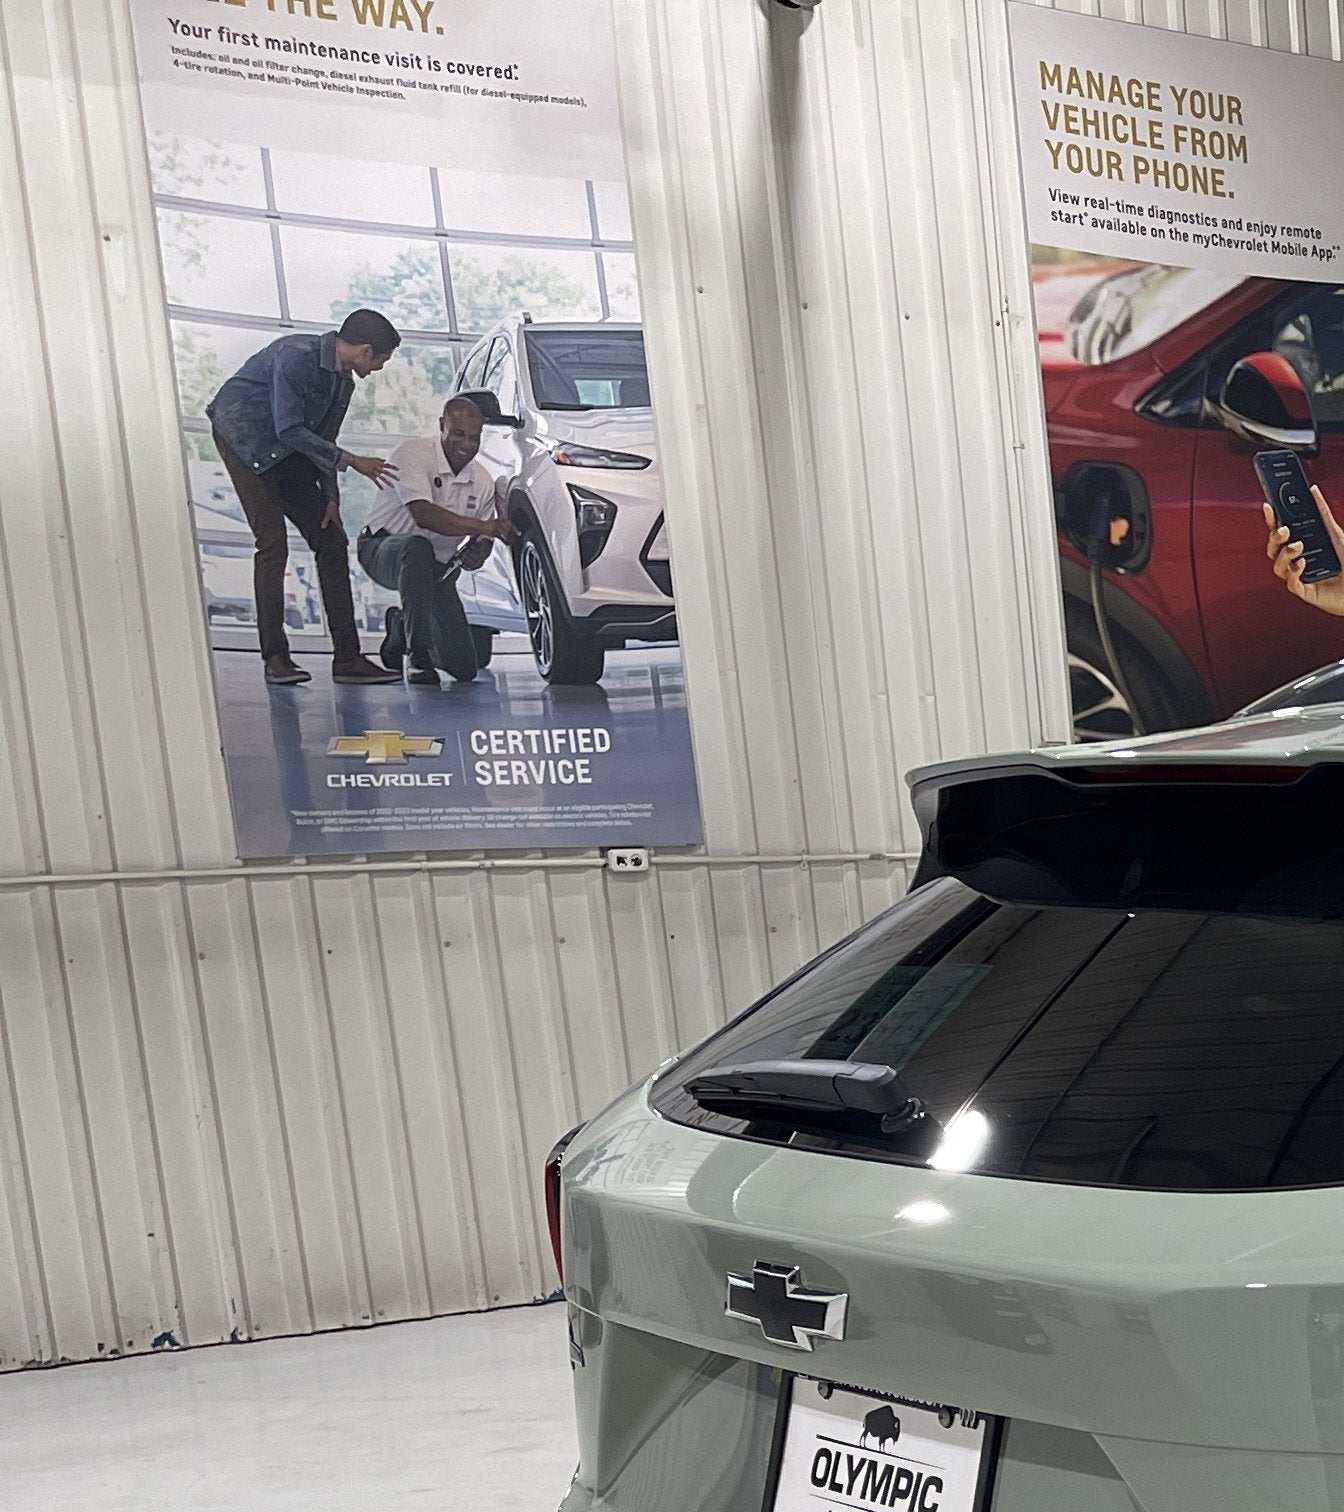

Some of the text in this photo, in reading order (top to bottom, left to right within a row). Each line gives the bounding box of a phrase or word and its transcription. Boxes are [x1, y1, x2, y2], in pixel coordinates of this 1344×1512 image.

[352, 0, 444, 35] WAY.
[167, 17, 211, 40] Your
[217, 25, 260, 48] first
[264, 36, 381, 65] maintenance
[385, 51, 423, 70] visit
[427, 55, 442, 72] is
[172, 58, 406, 100] 4-tire rotation, and Multi-Point Vehicle Inspection.
[218, 53, 230, 63] oil
[232, 57, 250, 67] and
[251, 57, 263, 68] oil
[265, 60, 289, 72] filter
[291, 65, 328, 79] change,
[329, 70, 357, 81] diesel
[358, 75, 394, 87] exhaust
[396, 78, 417, 89] fluid
[418, 81, 439, 92] tank
[440, 84, 461, 94] refill
[462, 84, 478, 96] (for
[481, 88, 549, 104] diesel-equipped
[1039, 61, 1244, 126] MANAGE YOUR
[1041, 100, 1248, 164] VEHICLE FROM
[1044, 139, 1235, 199] YOUR PHONE.
[1048, 187, 1322, 240] View real-time diagnostics and enjoy remote
[1091, 217, 1147, 236] available
[1150, 226, 1166, 239] on
[1169, 227, 1189, 243] the
[1192, 232, 1269, 253] myChevrolet
[1271, 241, 1308, 257] Mobile
[470, 727, 611, 755] CERTIFIED
[326, 773, 453, 788] CHEVROLET
[474, 759, 592, 786] SERVICE
